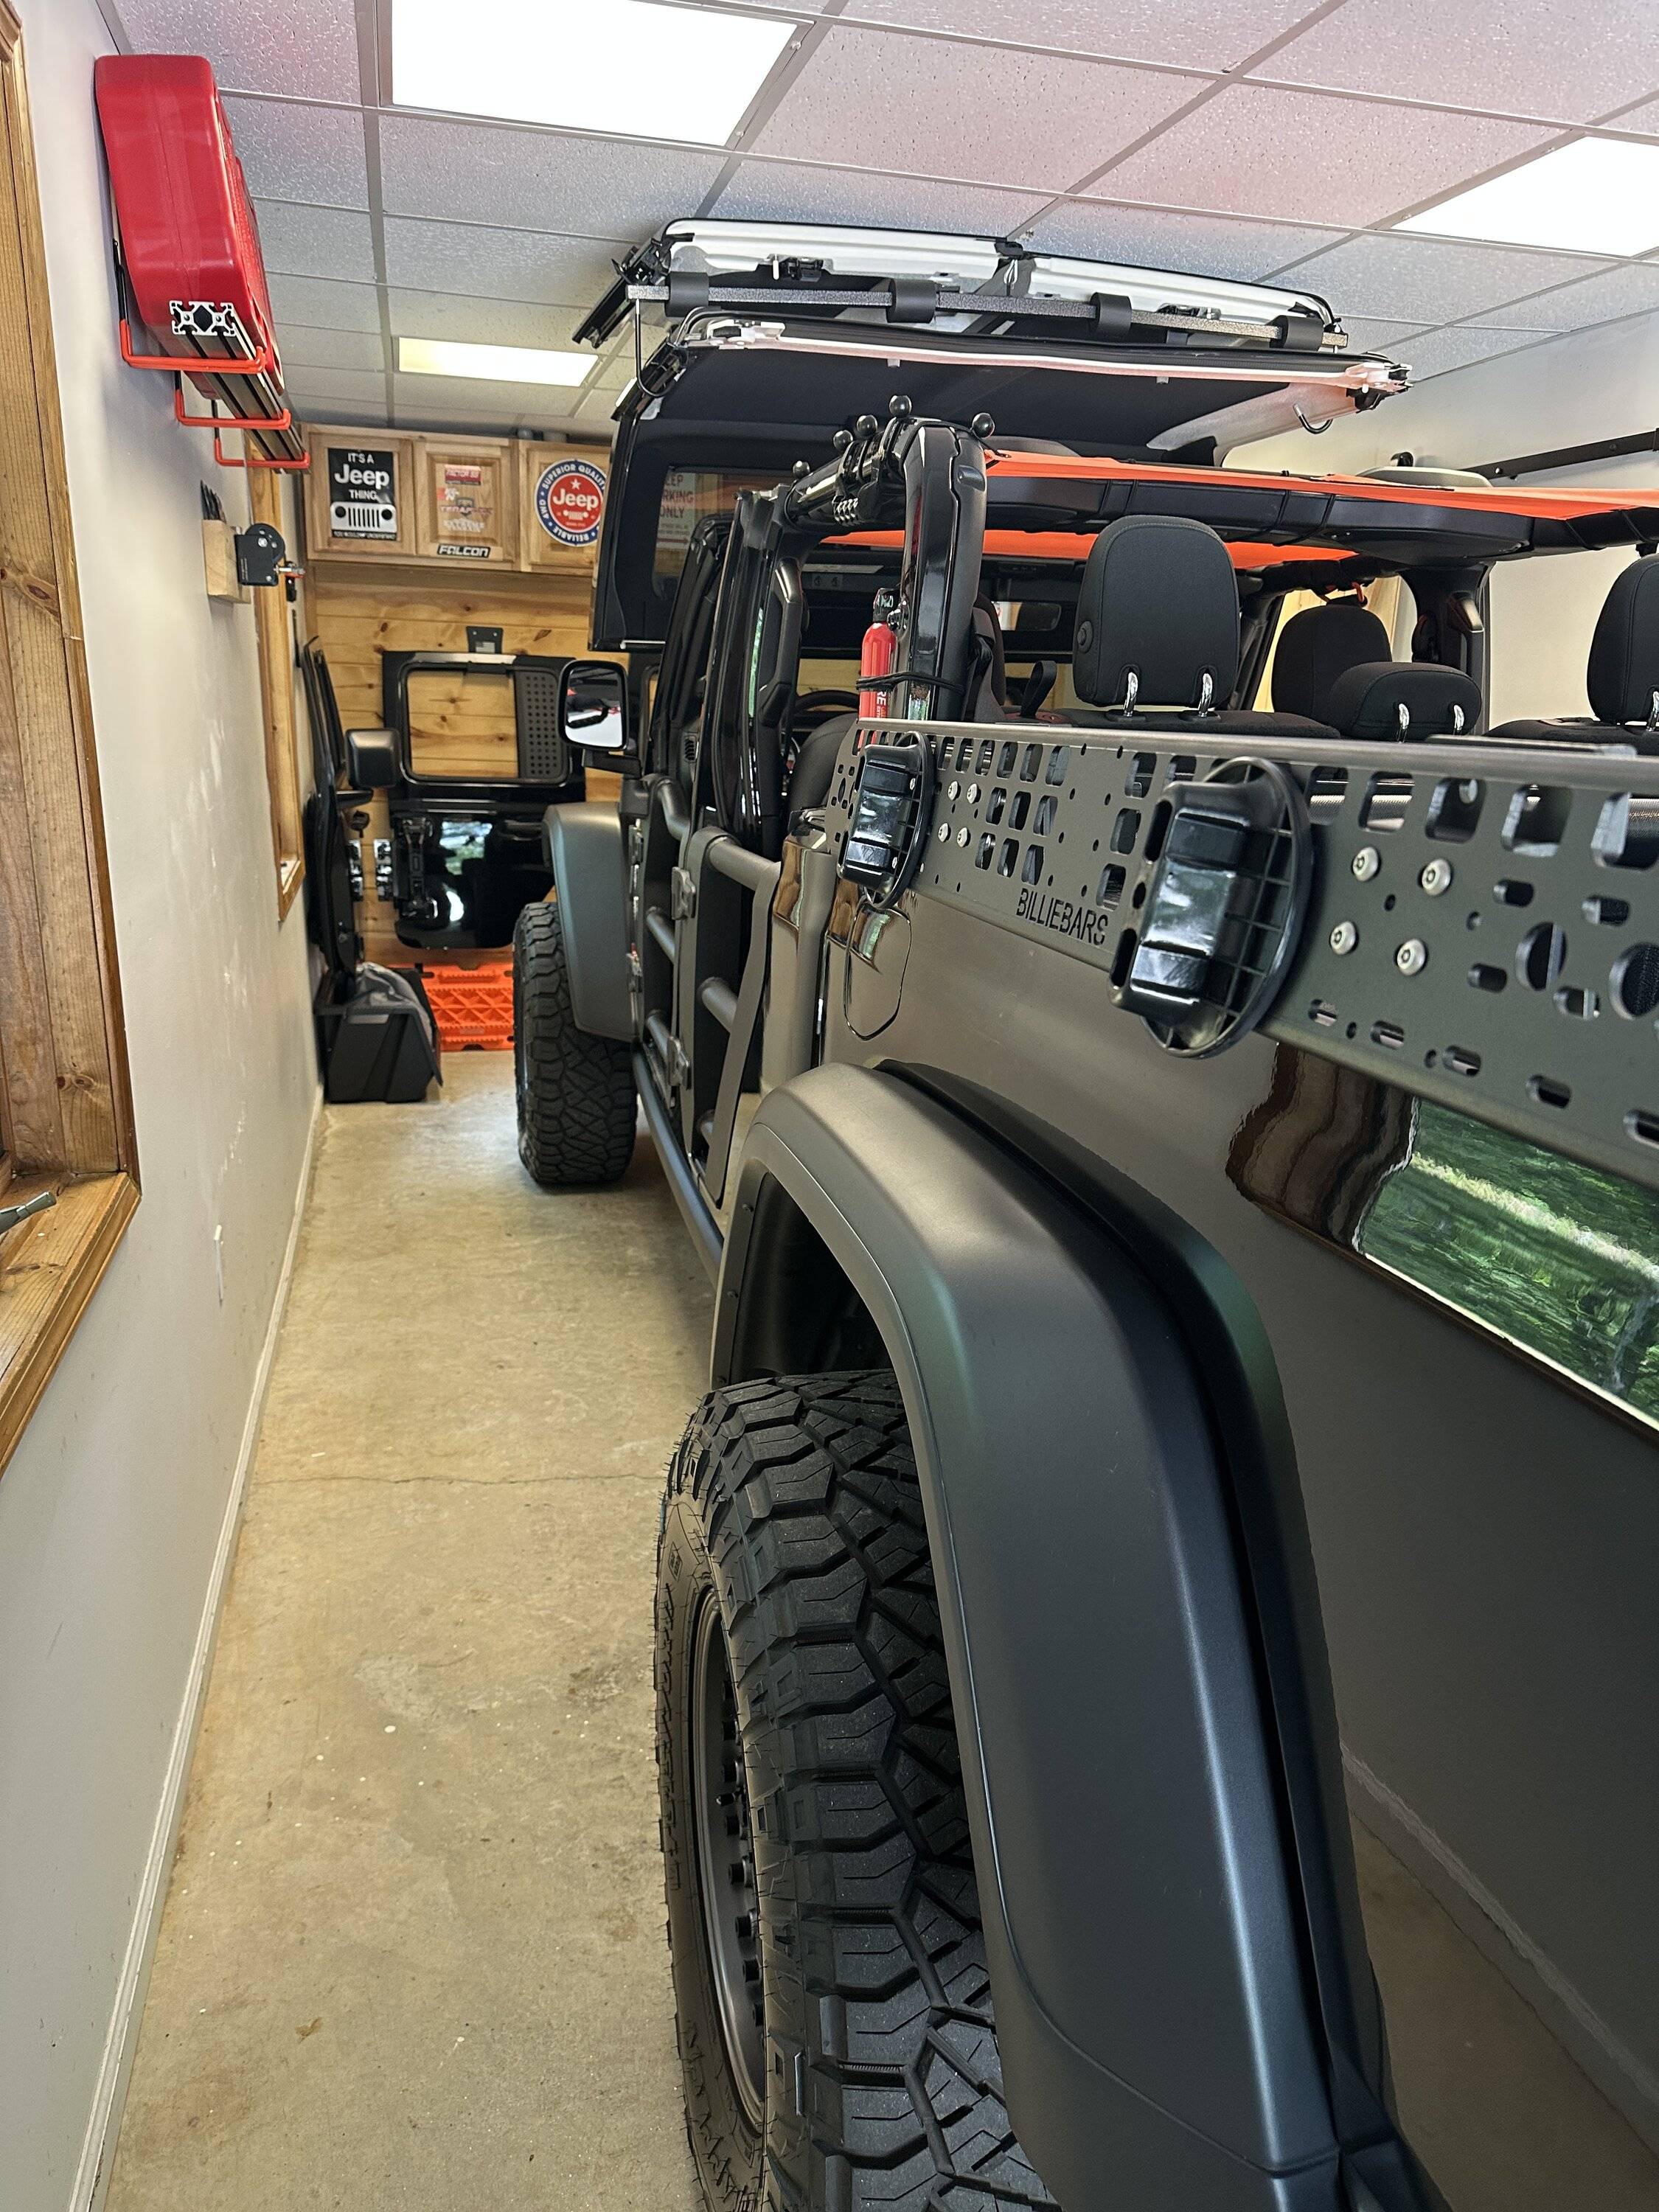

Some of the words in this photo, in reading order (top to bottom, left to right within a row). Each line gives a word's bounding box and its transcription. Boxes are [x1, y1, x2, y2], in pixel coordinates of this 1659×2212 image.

[366, 453, 375, 465] A
[334, 463, 390, 490] Jeep
[542, 464, 576, 489] SUPERIOR
[349, 489, 378, 501] THING
[552, 487, 599, 511] Jeep
[553, 526, 590, 542] RELIABLE
[439, 545, 489, 557] FALCON
[1015, 887, 1109, 947] BILLIEBARS
